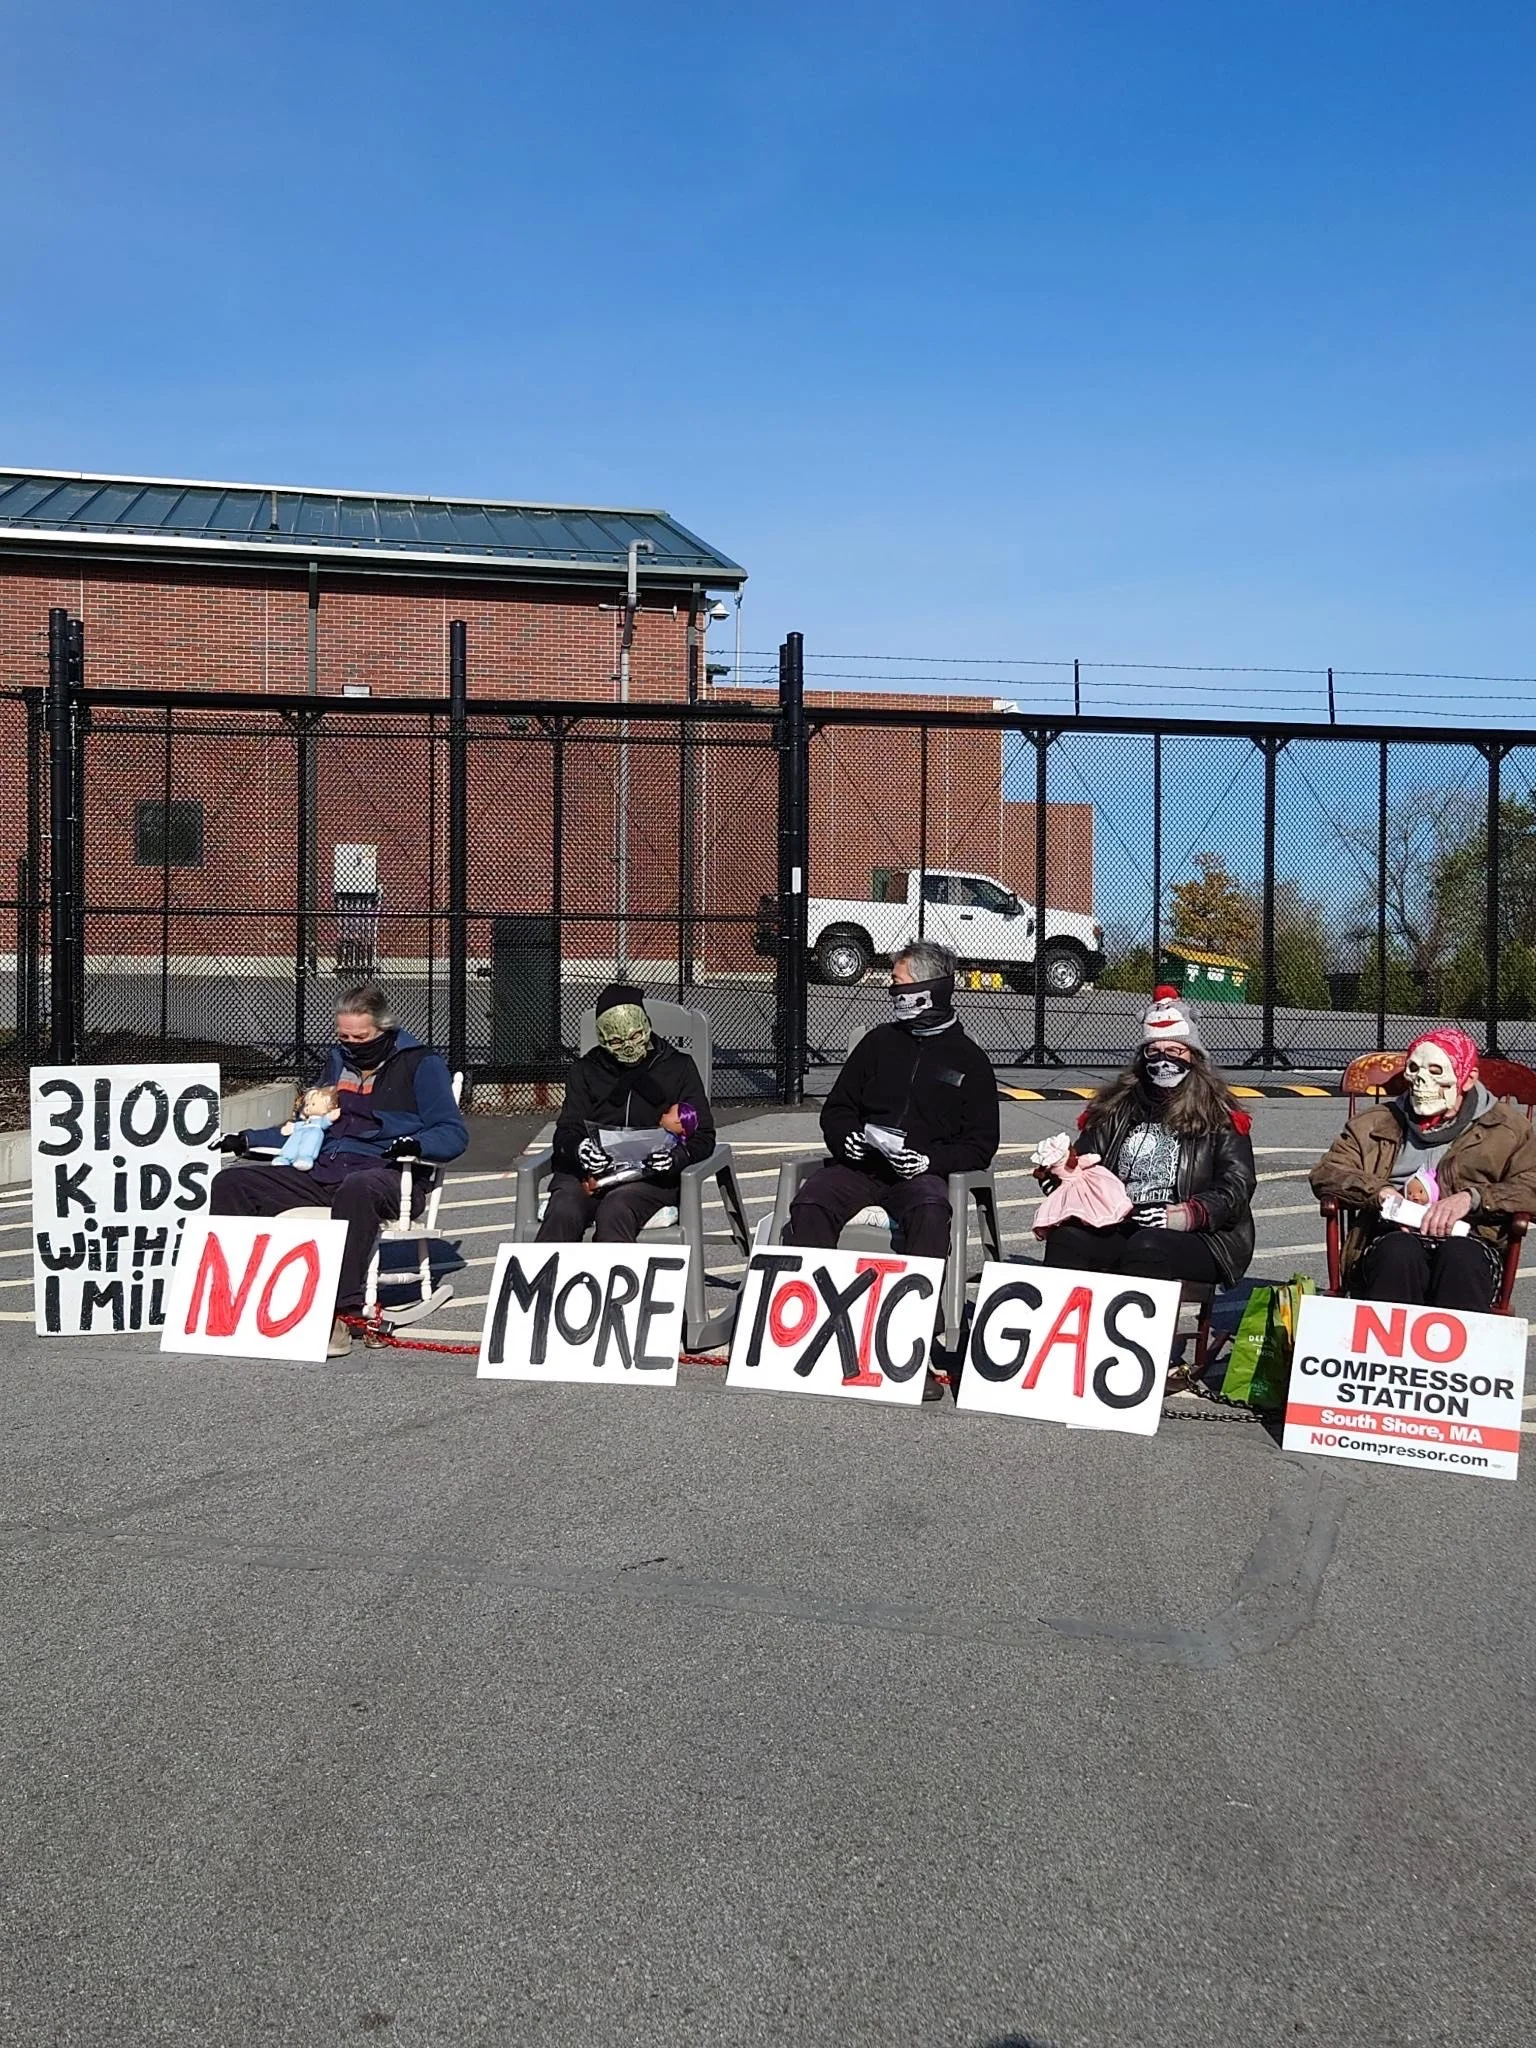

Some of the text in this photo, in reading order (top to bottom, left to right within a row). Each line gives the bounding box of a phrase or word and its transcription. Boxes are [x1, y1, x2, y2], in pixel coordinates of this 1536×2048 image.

[38, 1078, 218, 1156] 3100
[184, 1231, 320, 1338] NO
[489, 1251, 686, 1370] MORE
[745, 1254, 934, 1387] TOXIC
[971, 1281, 1156, 1409] GAS
[1350, 1304, 1467, 1363] NO
[1300, 1355, 1514, 1400] COMPRESSOR
[1337, 1383, 1469, 1417] STATION
[1310, 1432, 1489, 1468] NOCompressor.com
[1320, 1410, 1484, 1445] South Shore, MA
